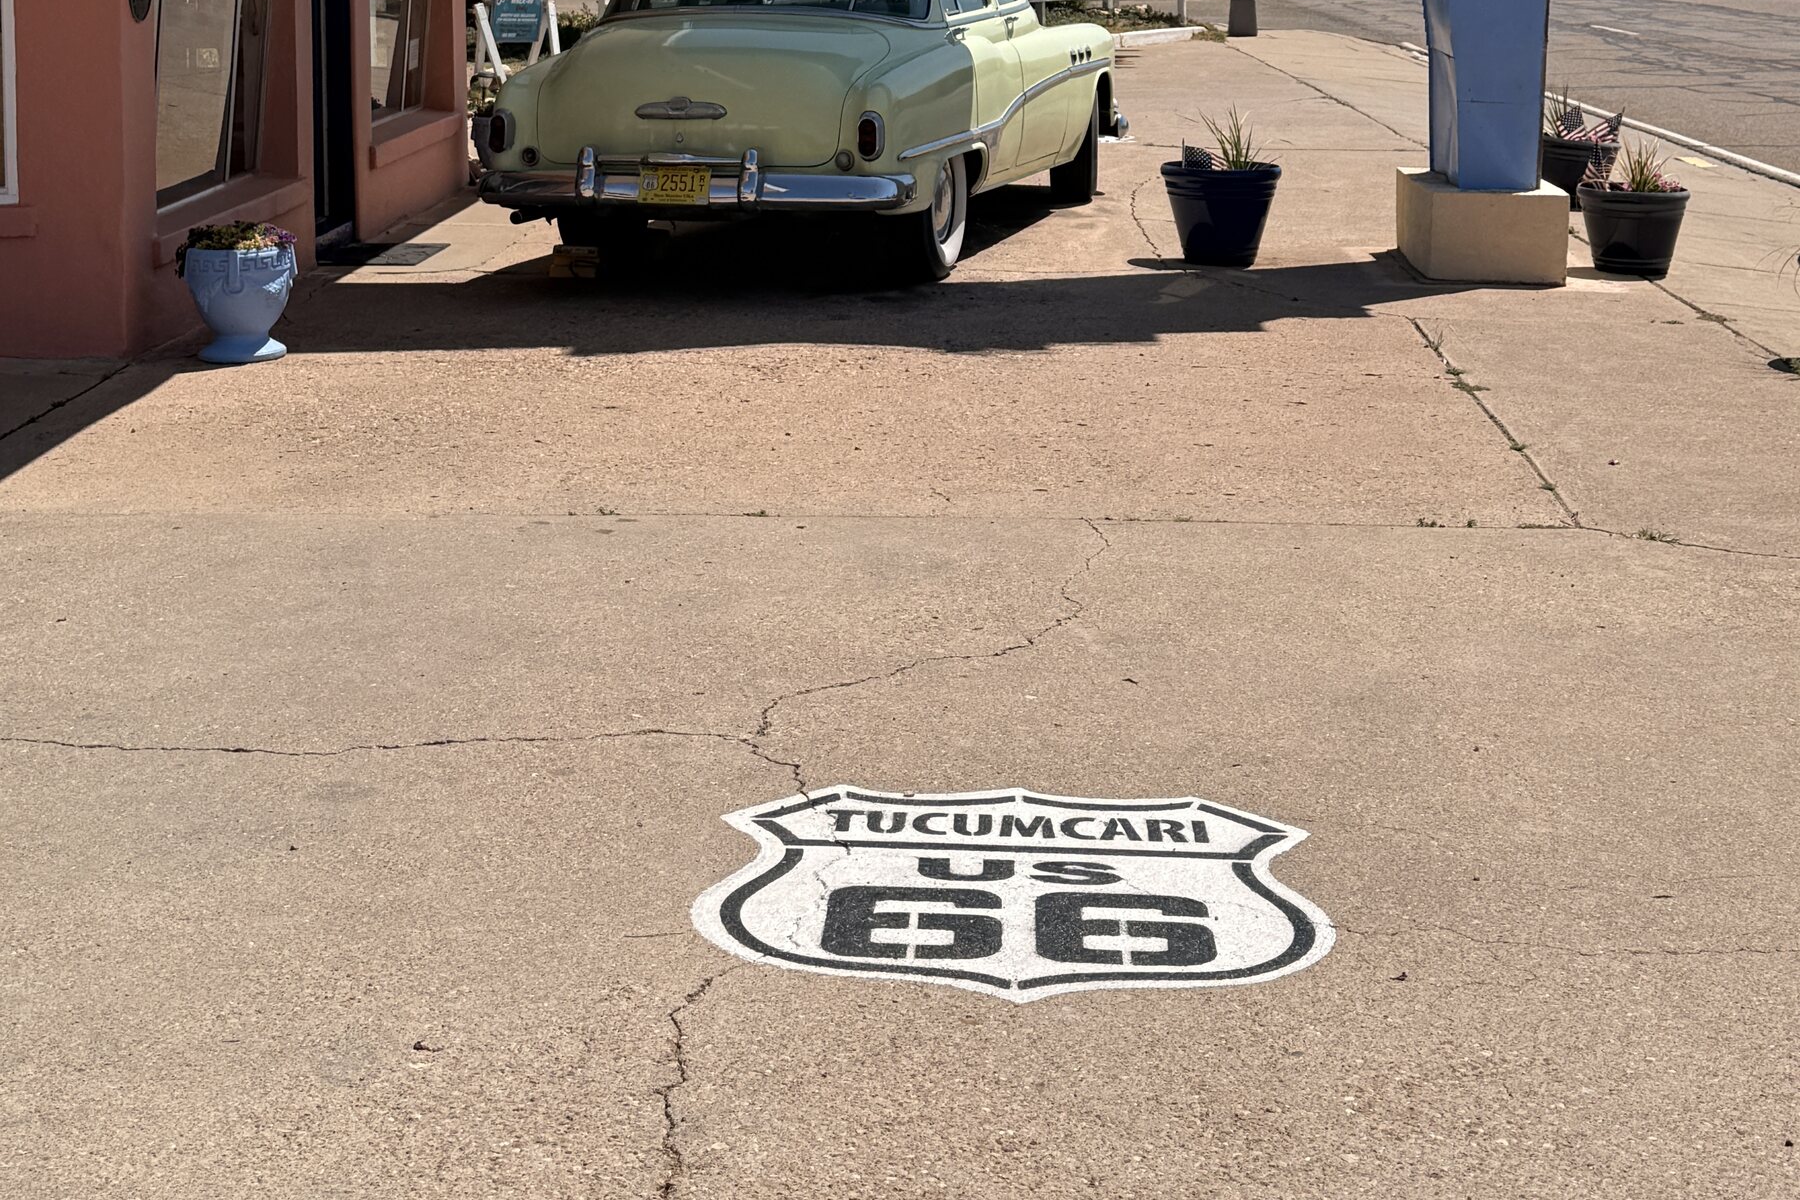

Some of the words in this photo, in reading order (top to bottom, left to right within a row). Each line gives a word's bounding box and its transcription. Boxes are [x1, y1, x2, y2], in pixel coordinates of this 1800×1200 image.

[660, 174, 696, 192] 2551
[828, 808, 1210, 845] TUCUMCARI
[916, 856, 1125, 886] US
[820, 885, 1219, 967] 66
